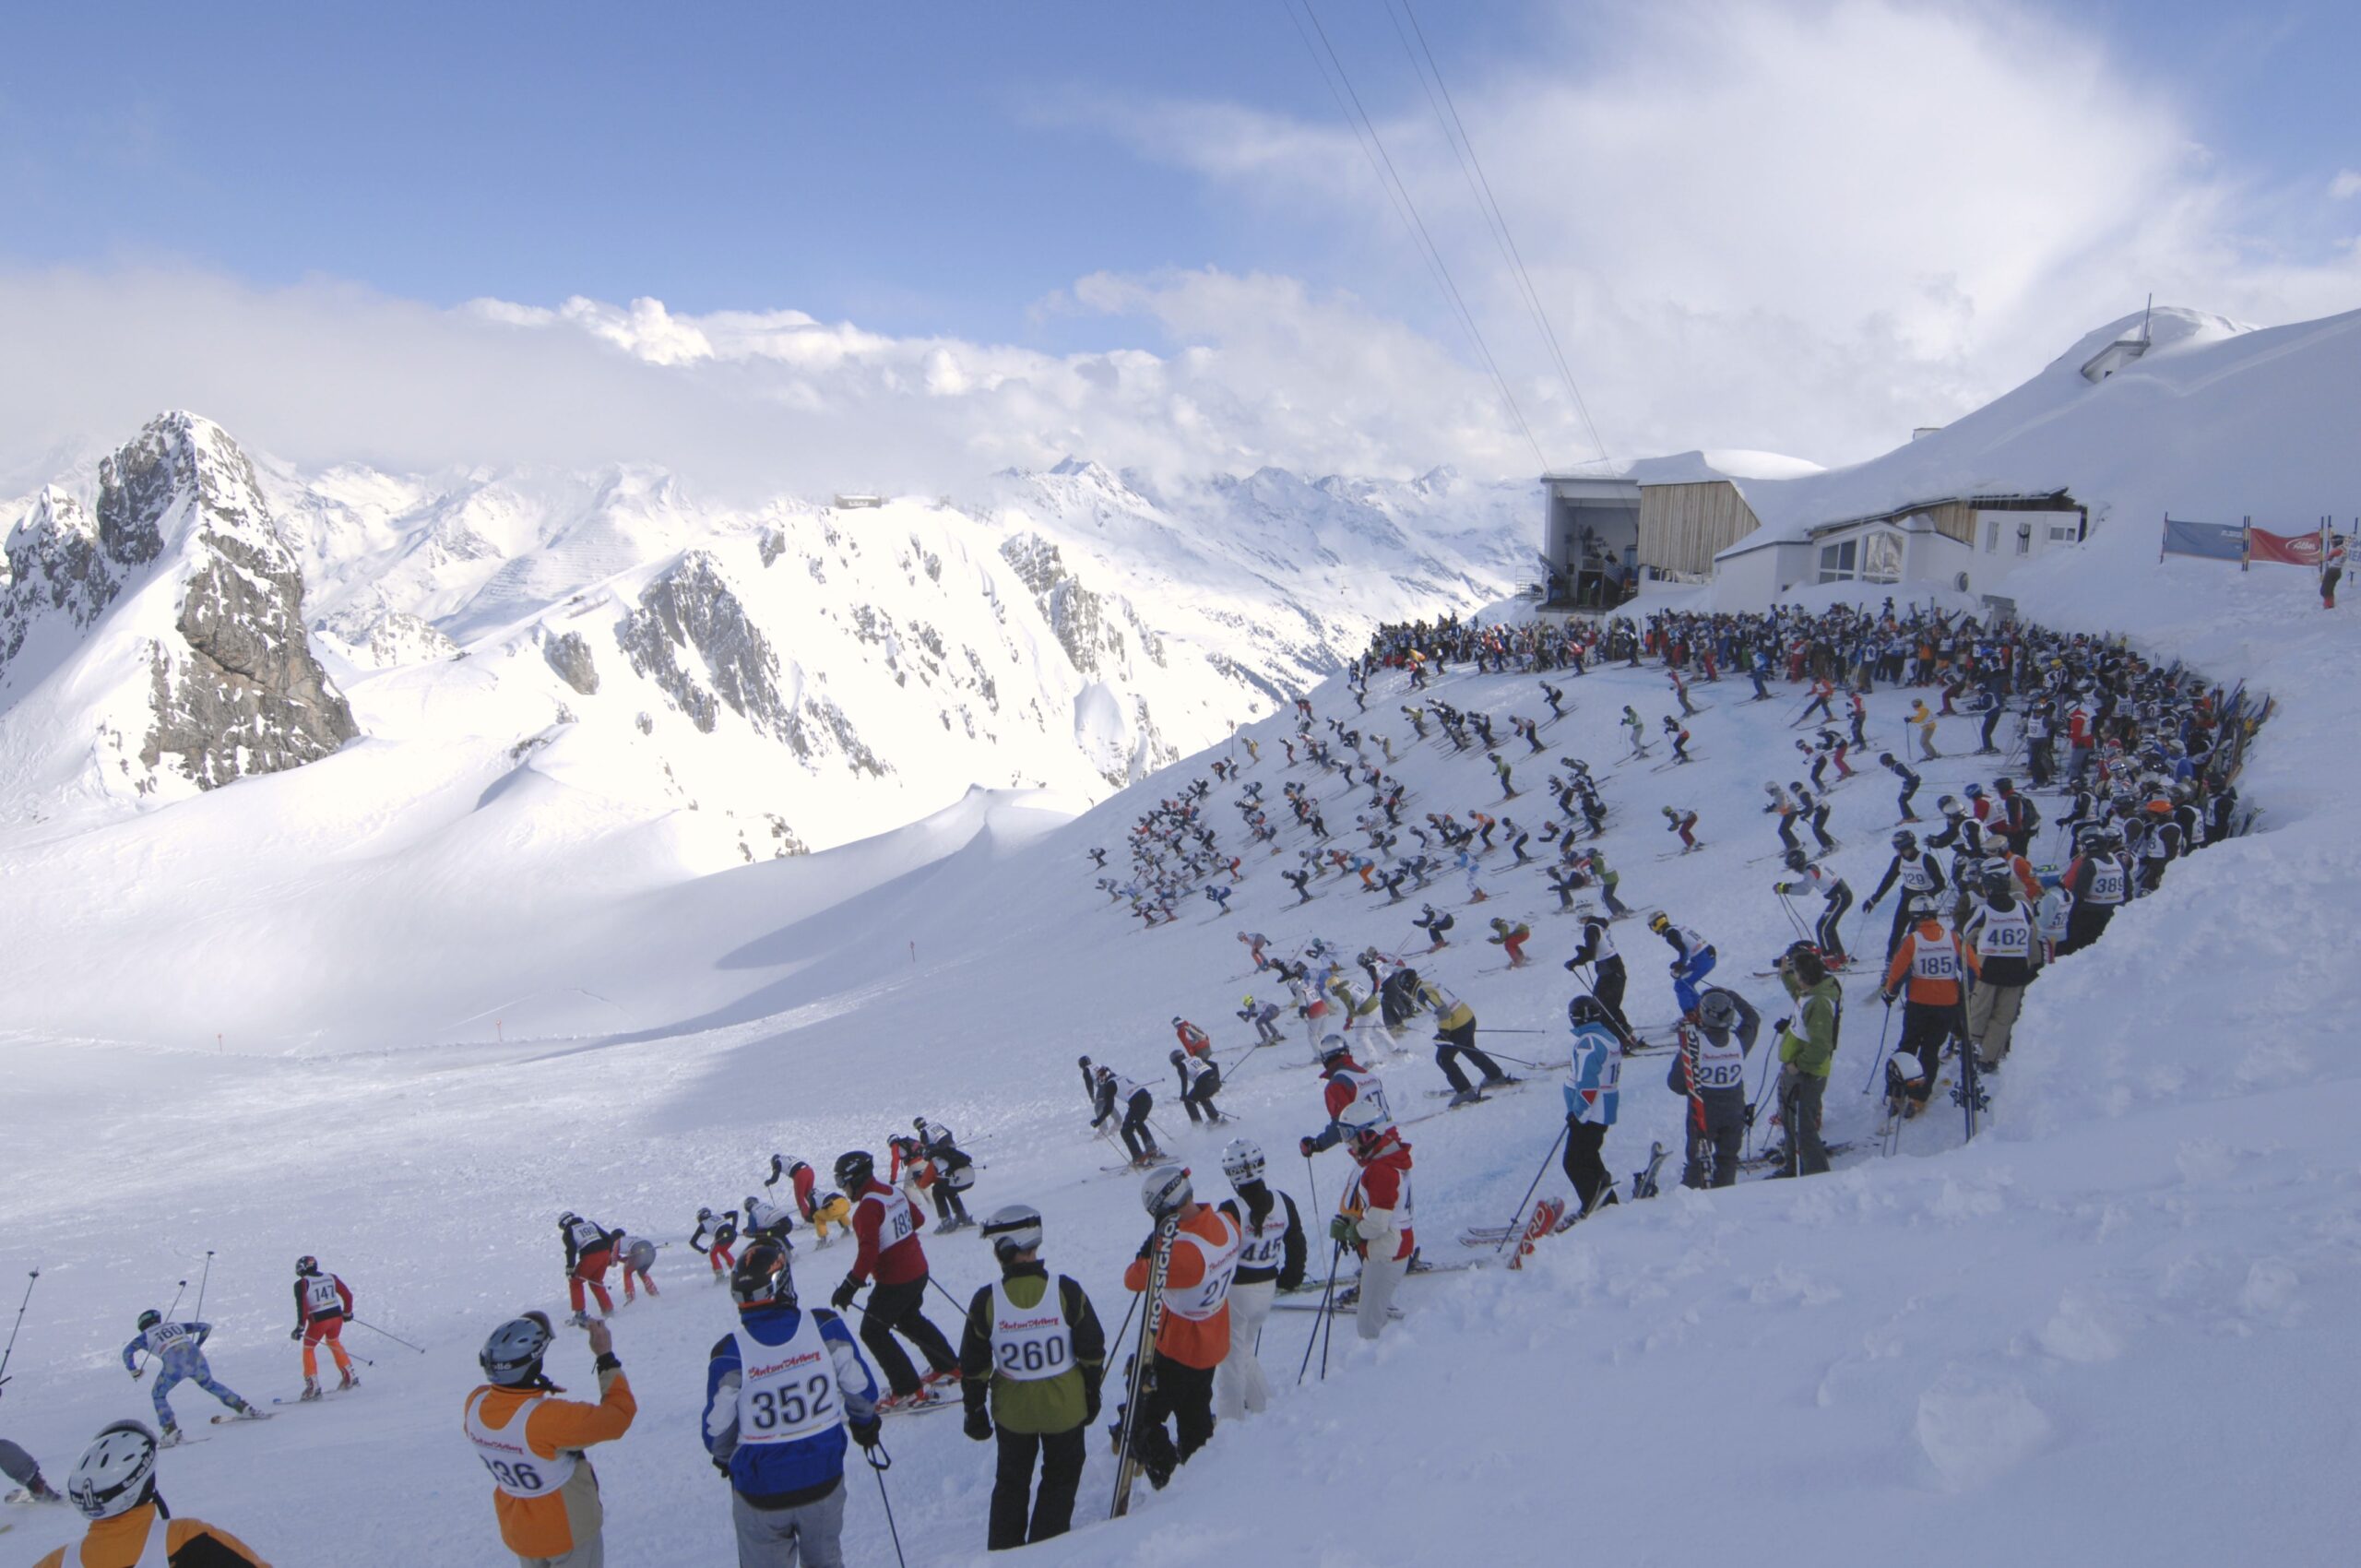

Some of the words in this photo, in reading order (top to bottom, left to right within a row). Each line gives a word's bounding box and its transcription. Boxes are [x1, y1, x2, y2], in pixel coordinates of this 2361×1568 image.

[1987, 928, 2027, 946] 462
[1920, 956, 1952, 975] 185
[1700, 1063, 1742, 1085] 262
[314, 1285, 335, 1302] 147
[1000, 1336, 1064, 1372] 260
[752, 1373, 834, 1431] 352
